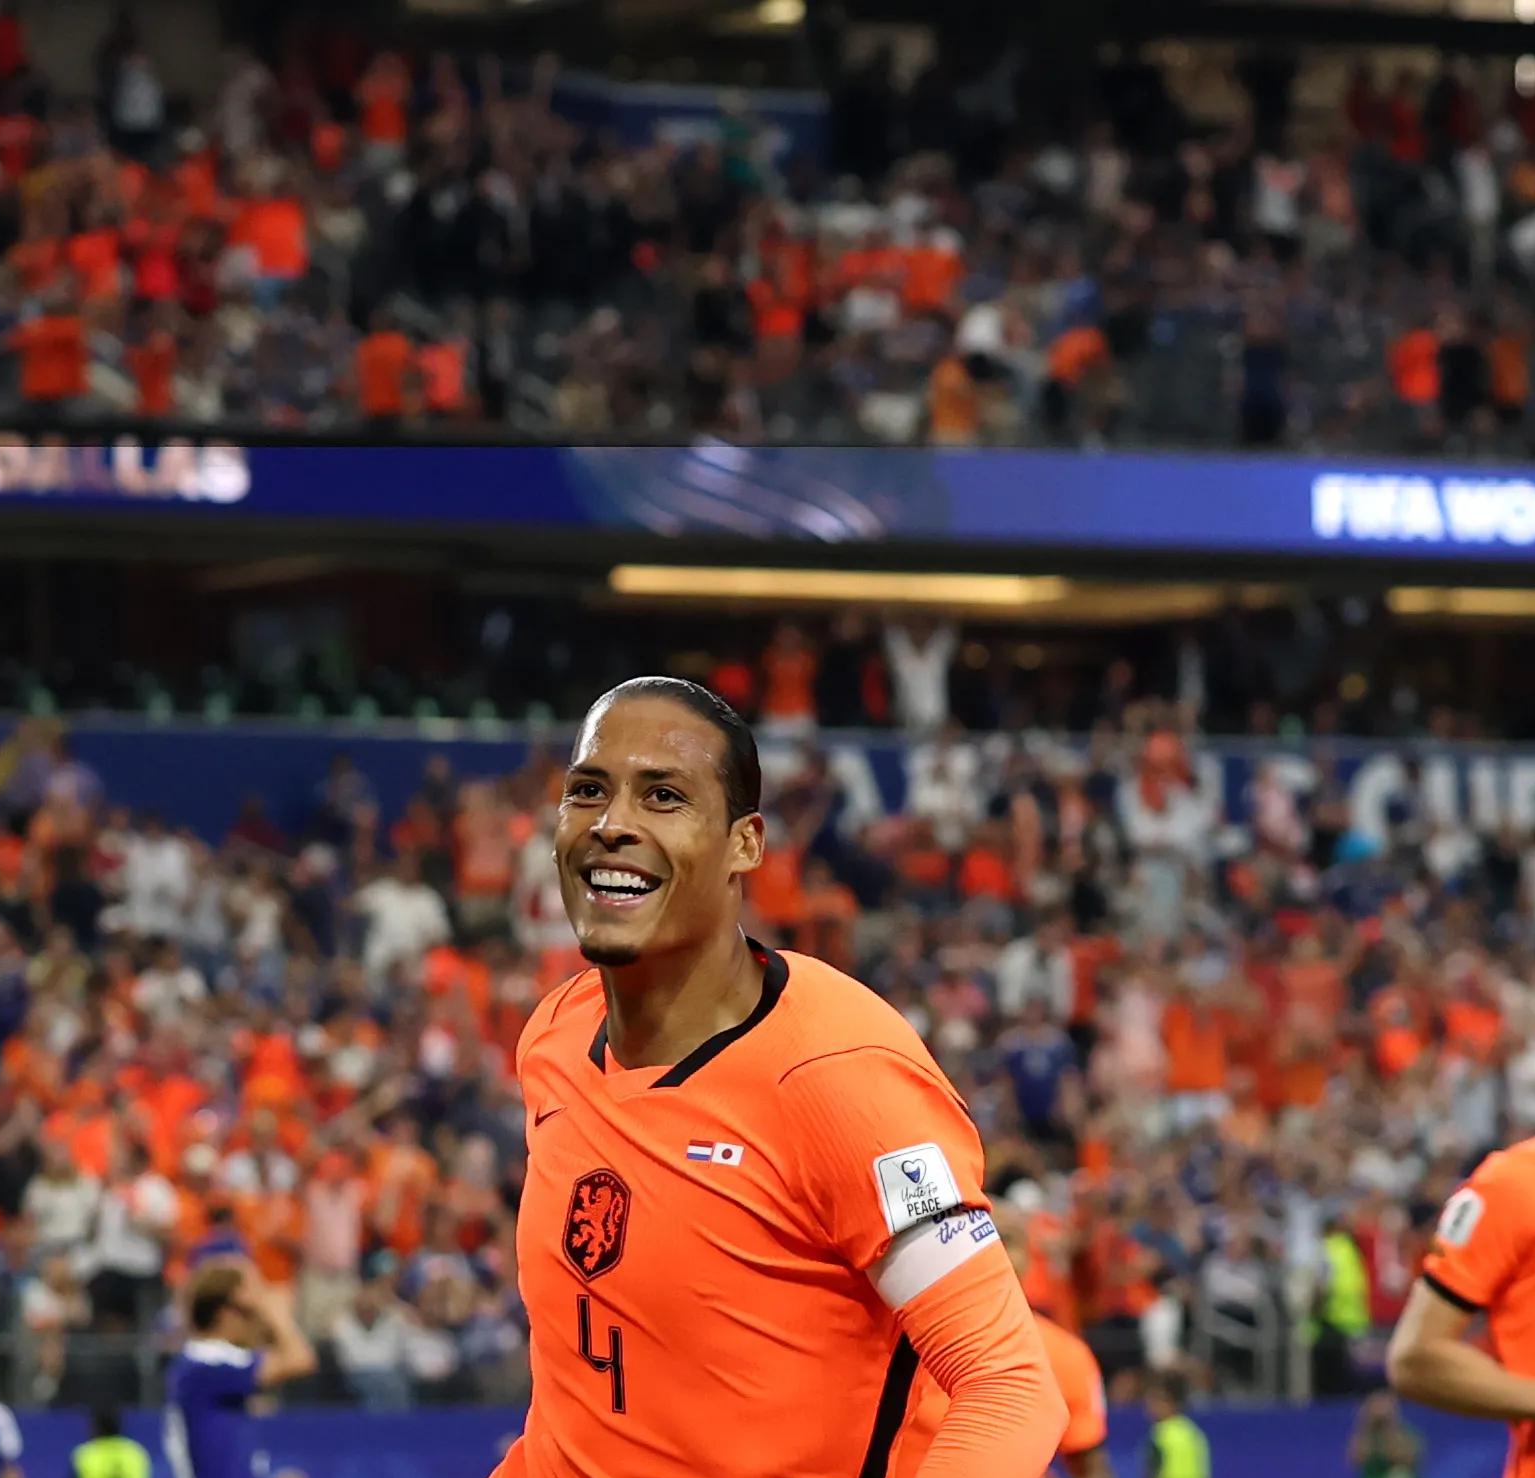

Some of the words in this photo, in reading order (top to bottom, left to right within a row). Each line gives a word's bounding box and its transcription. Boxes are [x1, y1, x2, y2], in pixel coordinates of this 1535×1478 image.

[1311, 473, 1444, 541] FIFA
[901, 1186, 925, 1202] Unite
[907, 1197, 942, 1217] PEACE
[935, 1221, 966, 1244] the
[576, 1293, 627, 1415] 4
